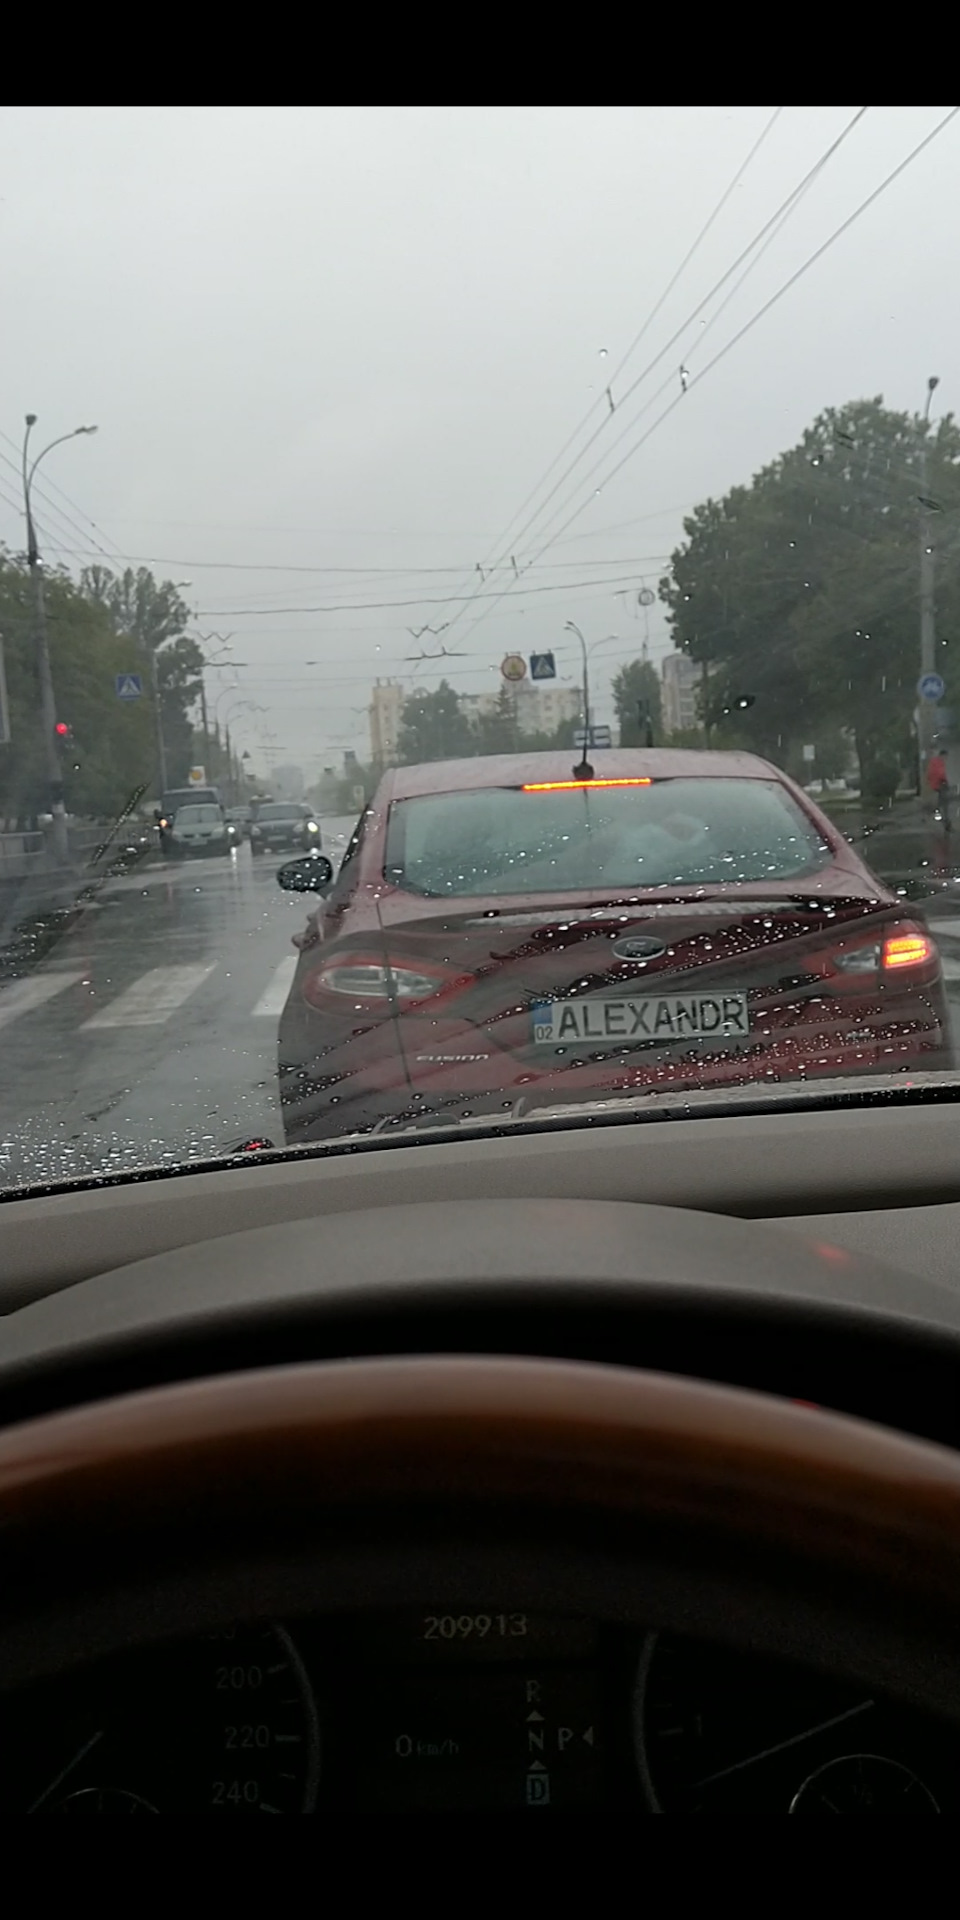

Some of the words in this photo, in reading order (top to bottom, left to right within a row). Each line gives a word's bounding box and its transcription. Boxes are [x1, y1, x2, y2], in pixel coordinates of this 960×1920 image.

[536, 1025, 553, 1041] 02
[558, 998, 745, 1038] ALEXANDR
[423, 1613, 528, 1640] 209913
[215, 1665, 263, 1689] 200
[526, 1680, 541, 1703] R
[223, 1725, 270, 1750] 220
[395, 1734, 413, 1757] 0
[416, 1738, 460, 1760] km/h
[528, 1728, 545, 1751] N
[557, 1727, 574, 1750] P
[211, 1780, 259, 1806] 240
[531, 1778, 546, 1800] D
